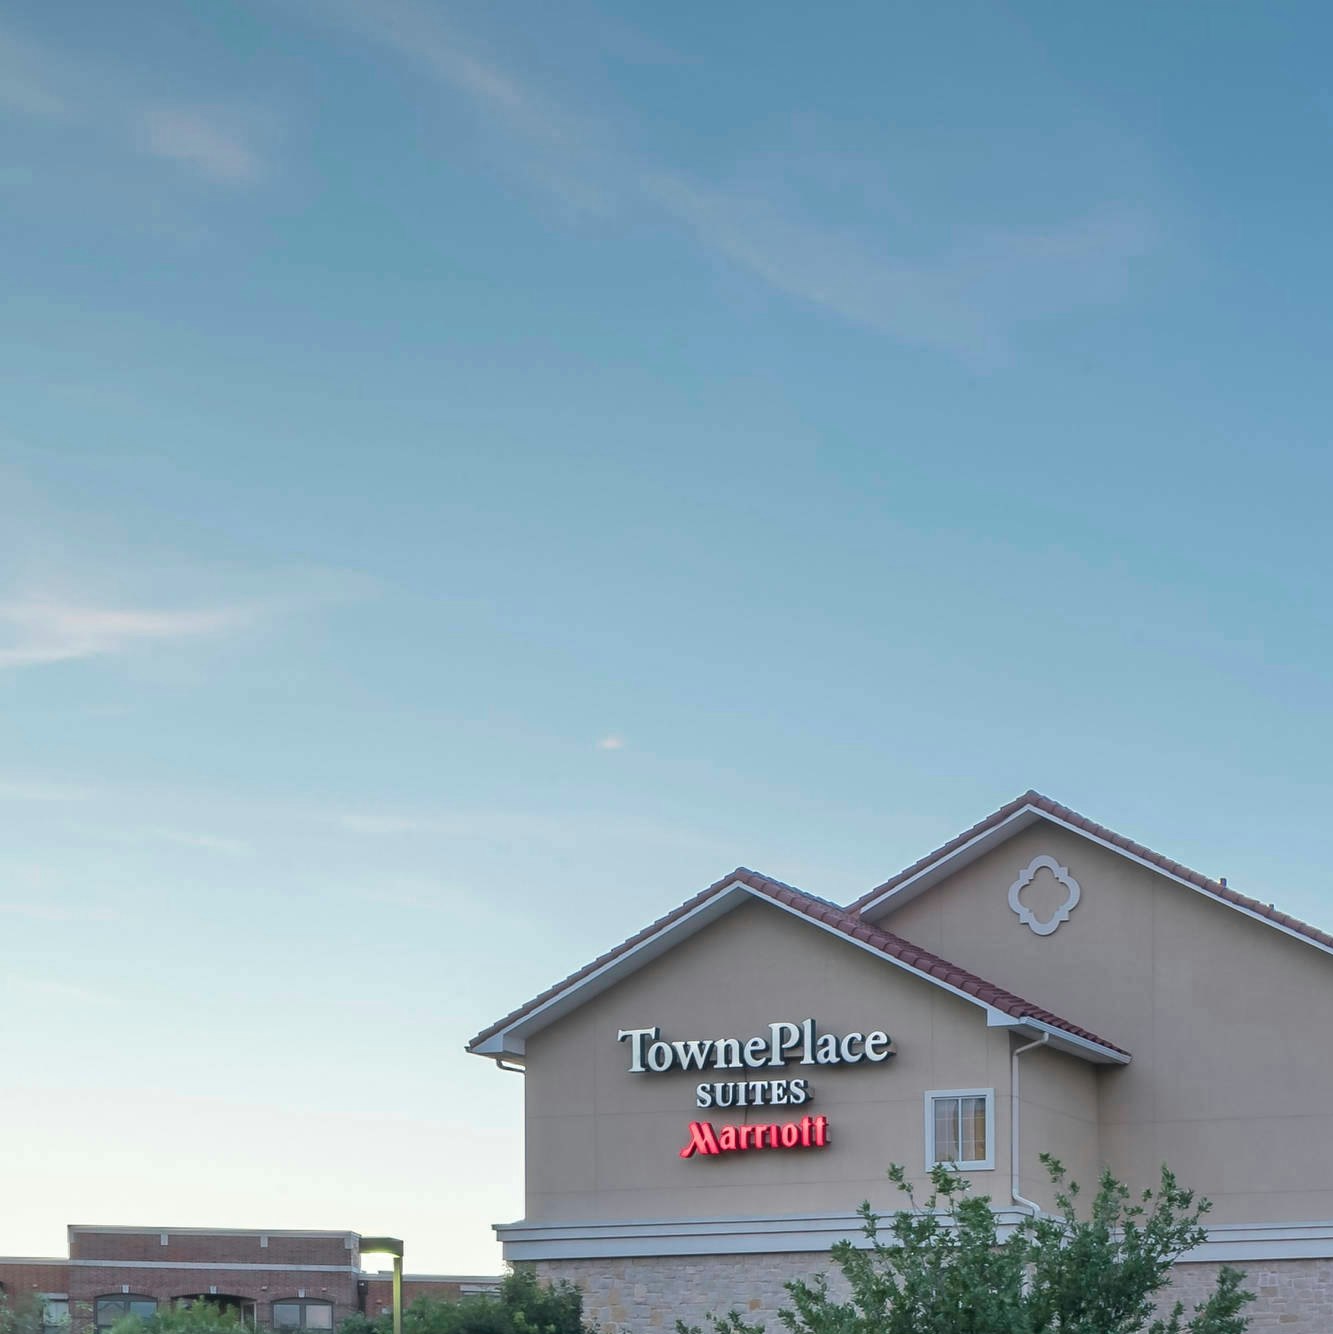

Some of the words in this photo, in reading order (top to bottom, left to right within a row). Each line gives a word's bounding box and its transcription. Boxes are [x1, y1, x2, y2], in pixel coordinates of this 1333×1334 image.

[617, 1017, 893, 1074] TownePlace
[696, 1079, 808, 1108] SUITES
[679, 1115, 829, 1158] Marriott
